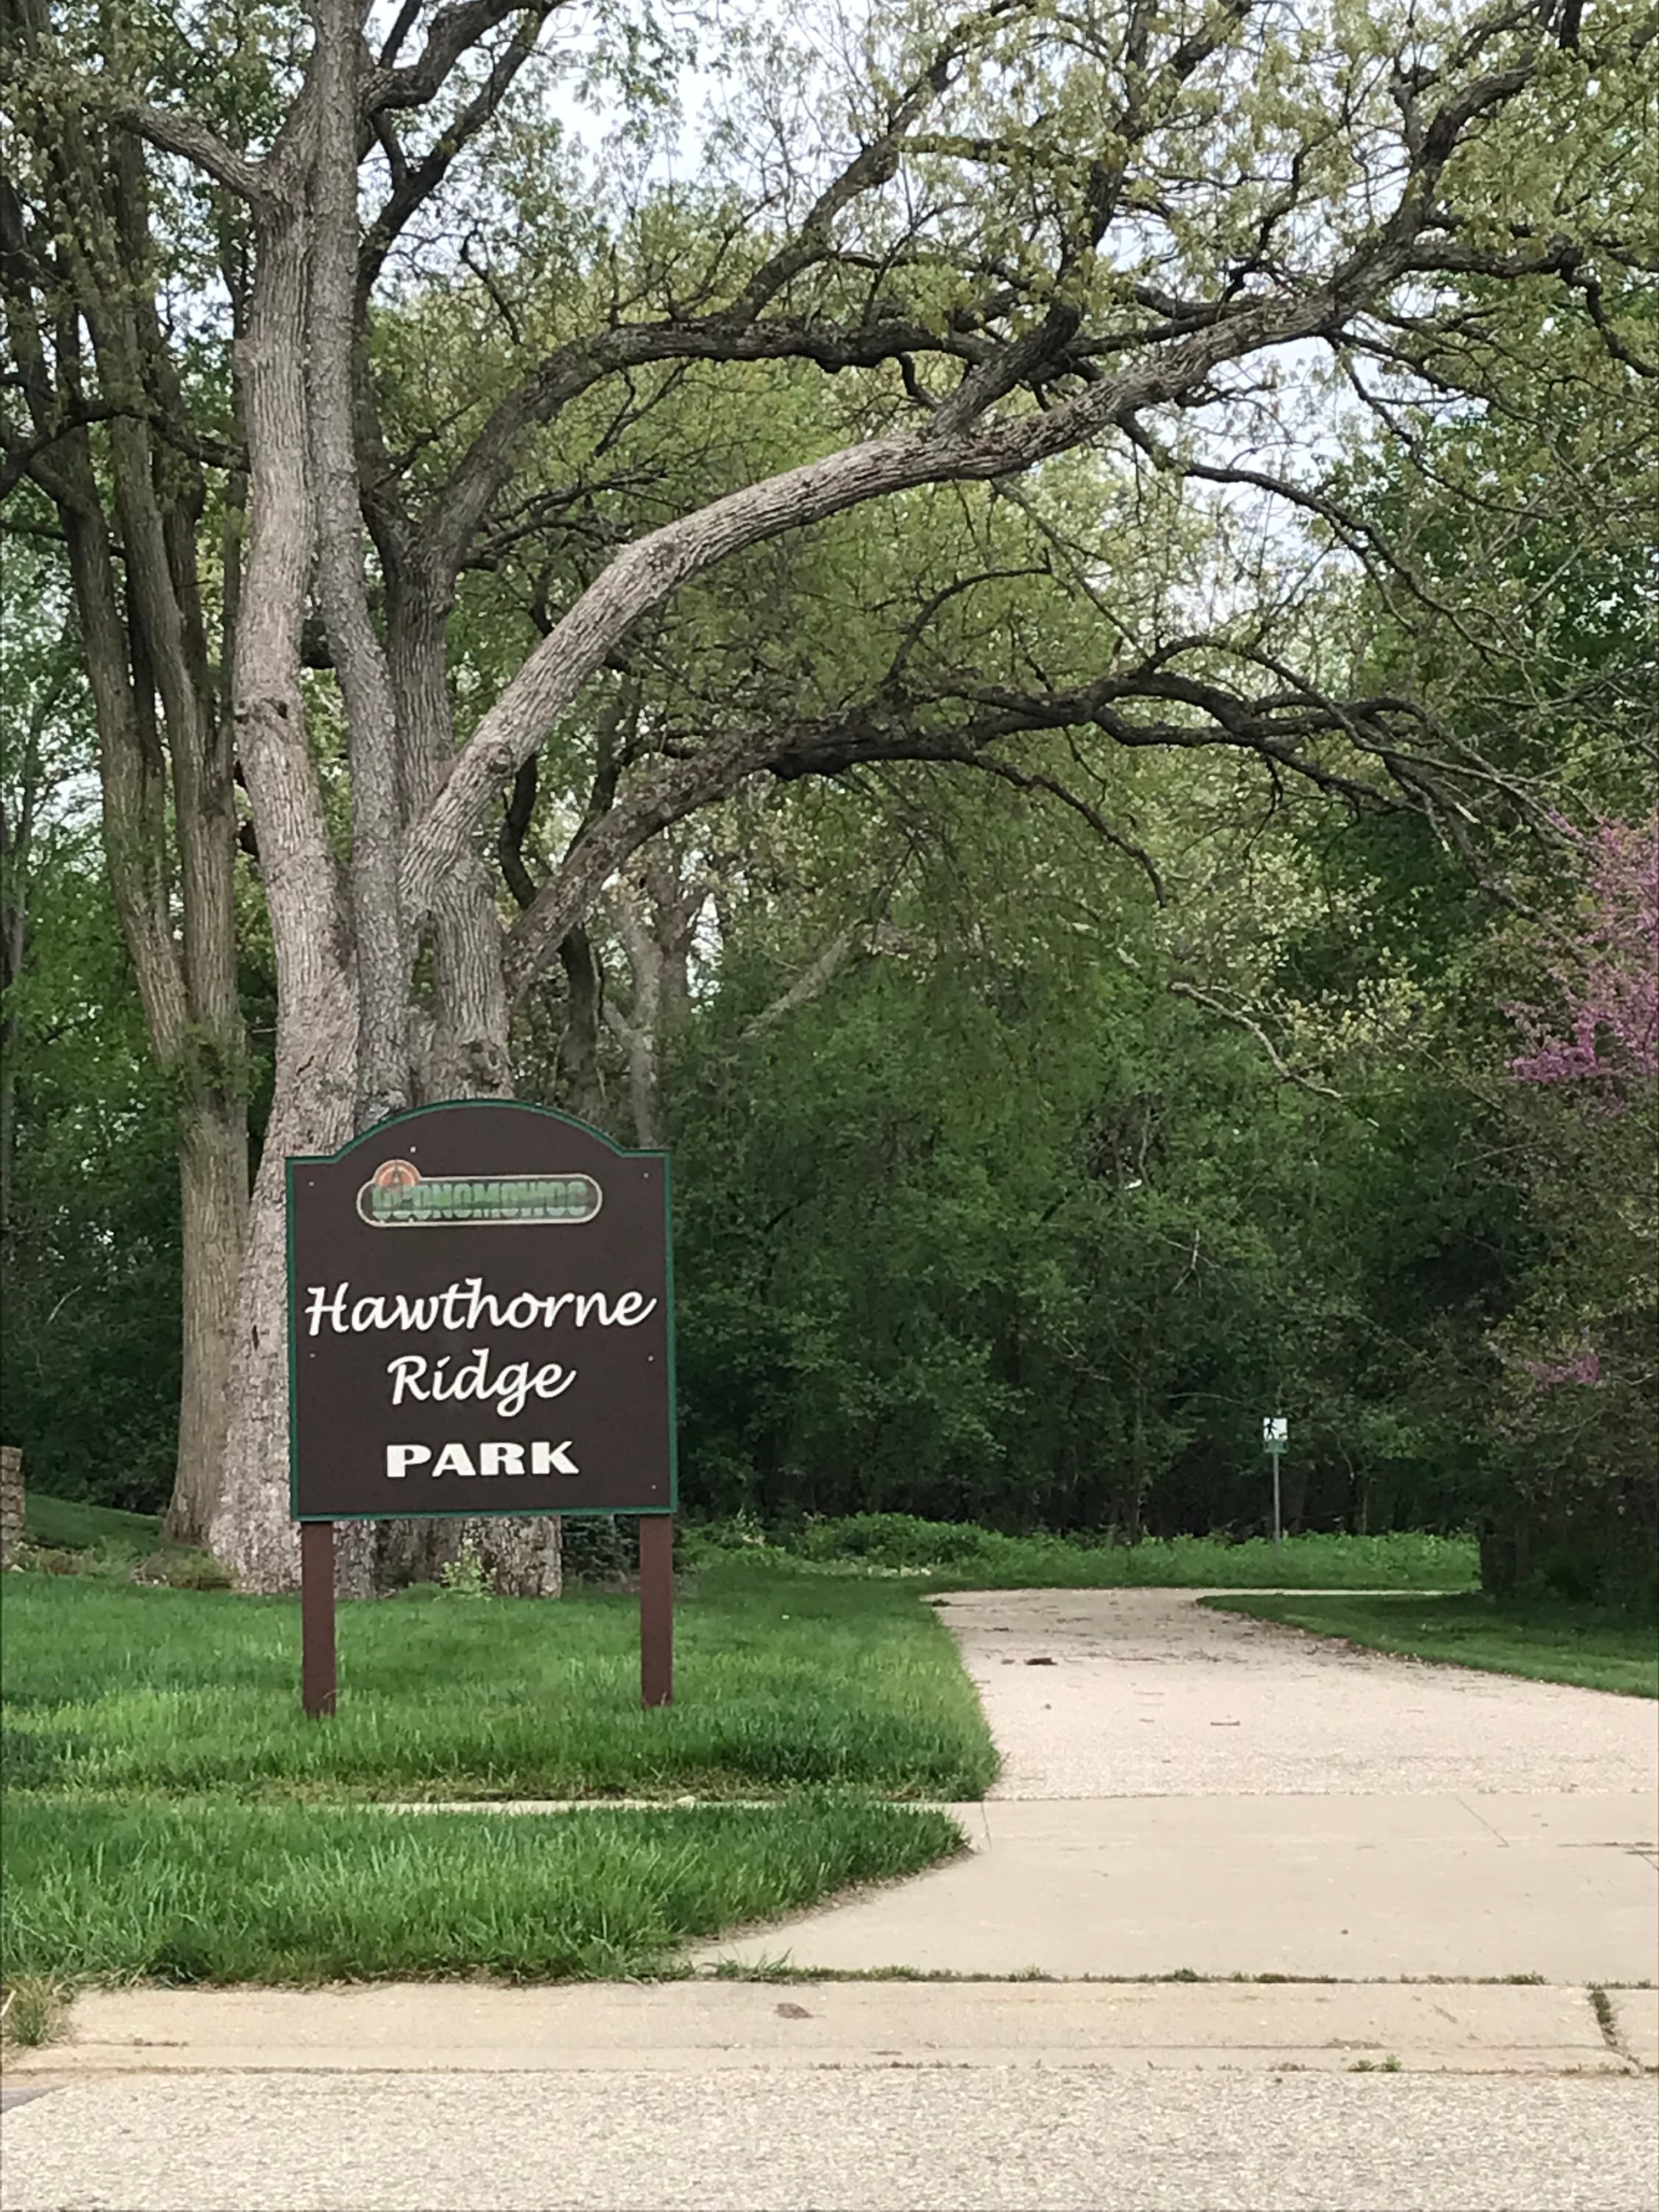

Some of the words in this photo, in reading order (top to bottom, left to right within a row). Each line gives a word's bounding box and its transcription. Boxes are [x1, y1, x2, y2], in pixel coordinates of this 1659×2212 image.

[304, 1277, 657, 1336] Hawthorne
[387, 1347, 576, 1418] Ridge
[386, 1441, 579, 1477] PARK
